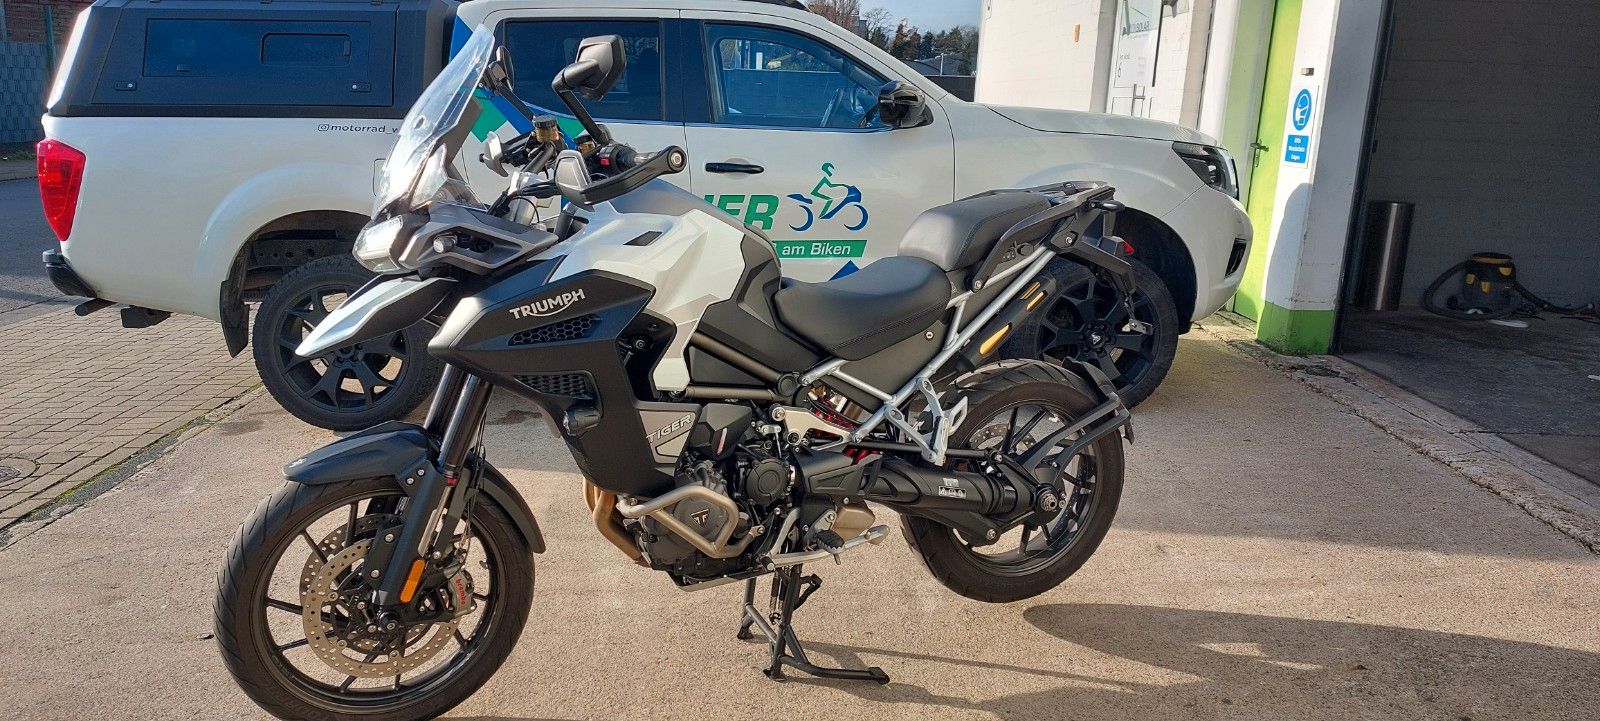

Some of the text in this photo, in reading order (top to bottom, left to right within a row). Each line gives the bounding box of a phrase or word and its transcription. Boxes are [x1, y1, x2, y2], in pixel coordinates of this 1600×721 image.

[704, 194, 780, 230] ER
[782, 245, 805, 255] am
[810, 242, 851, 255] Biken
[509, 288, 586, 319] TRIUMPH
[645, 414, 692, 443] TIGER
[455, 578, 466, 605] brembo
